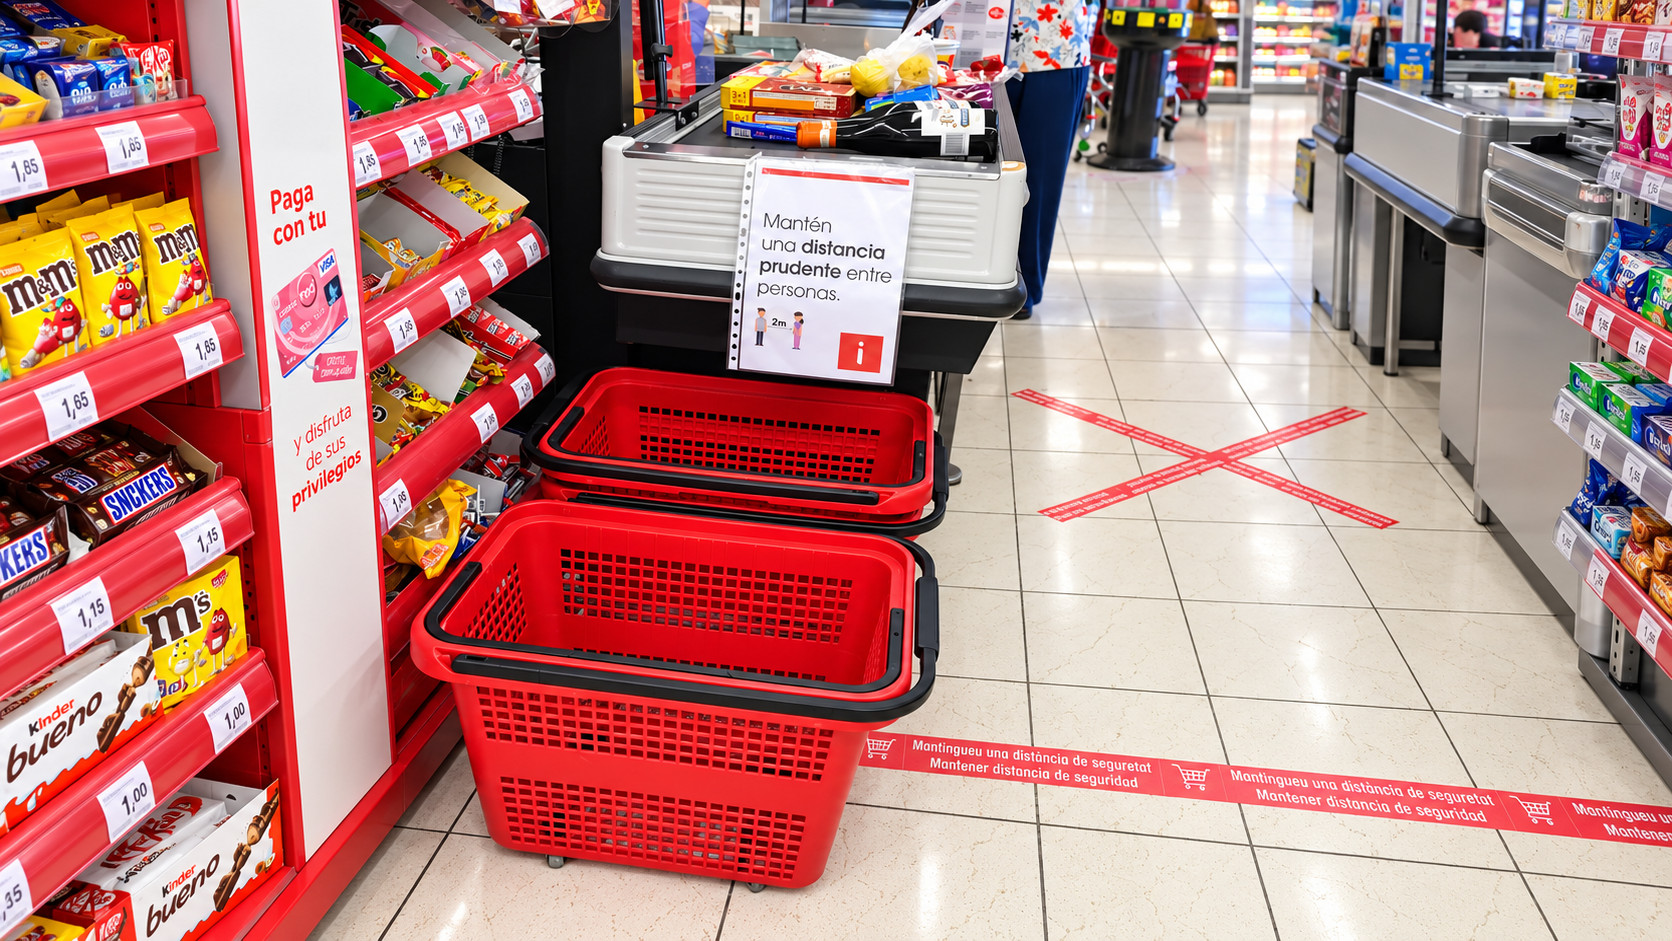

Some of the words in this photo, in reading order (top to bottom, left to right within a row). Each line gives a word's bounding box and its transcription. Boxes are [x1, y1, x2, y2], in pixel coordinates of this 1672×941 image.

[119, 137, 142, 159] 1,65
[11, 158, 39, 183] 1,85
[270, 184, 314, 215] Paga
[273, 218, 305, 246] con
[308, 210, 327, 232] tu
[763, 212, 832, 234] Mantén
[319, 253, 336, 274] VISA
[761, 238, 796, 253] una
[801, 239, 886, 260] distancia
[759, 260, 841, 280] prudente
[846, 268, 892, 284] entre
[757, 281, 841, 302] personas.
[772, 317, 787, 328] 2m
[195, 338, 216, 360] 1,65
[61, 390, 89, 420] 1,65
[294, 436, 302, 457] y
[305, 405, 352, 444] disfruta
[306, 450, 323, 471] de
[325, 436, 346, 459] sus
[292, 450, 362, 513] privilegios
[197, 527, 219, 553] 1,15
[78, 598, 105, 629] 1,15
[224, 702, 246, 730] 1,00
[7, 691, 103, 784] bueno
[912, 739, 983, 760] Mantingueu
[986, 748, 1010, 761] una
[1013, 749, 1069, 766] distància
[1072, 753, 1089, 767] de
[1092, 758, 1152, 774] seguretat
[930, 757, 989, 774] Mantener
[993, 762, 1051, 780] distancia
[1054, 768, 1071, 782] de
[1074, 772, 1139, 790] seguridad
[1230, 769, 1308, 790] Mantingueu
[1311, 777, 1339, 791] una
[1341, 777, 1404, 799] distància
[1407, 784, 1425, 800] de
[1428, 788, 1496, 808] seguretat
[121, 782, 148, 816] 1,00
[1256, 789, 1322, 807] Mantener
[1326, 794, 1391, 814] distancia
[1394, 801, 1413, 816] de
[1415, 804, 1488, 824] seguridad
[1571, 802, 1658, 823] Mantingueu
[146, 853, 220, 938] bueno
